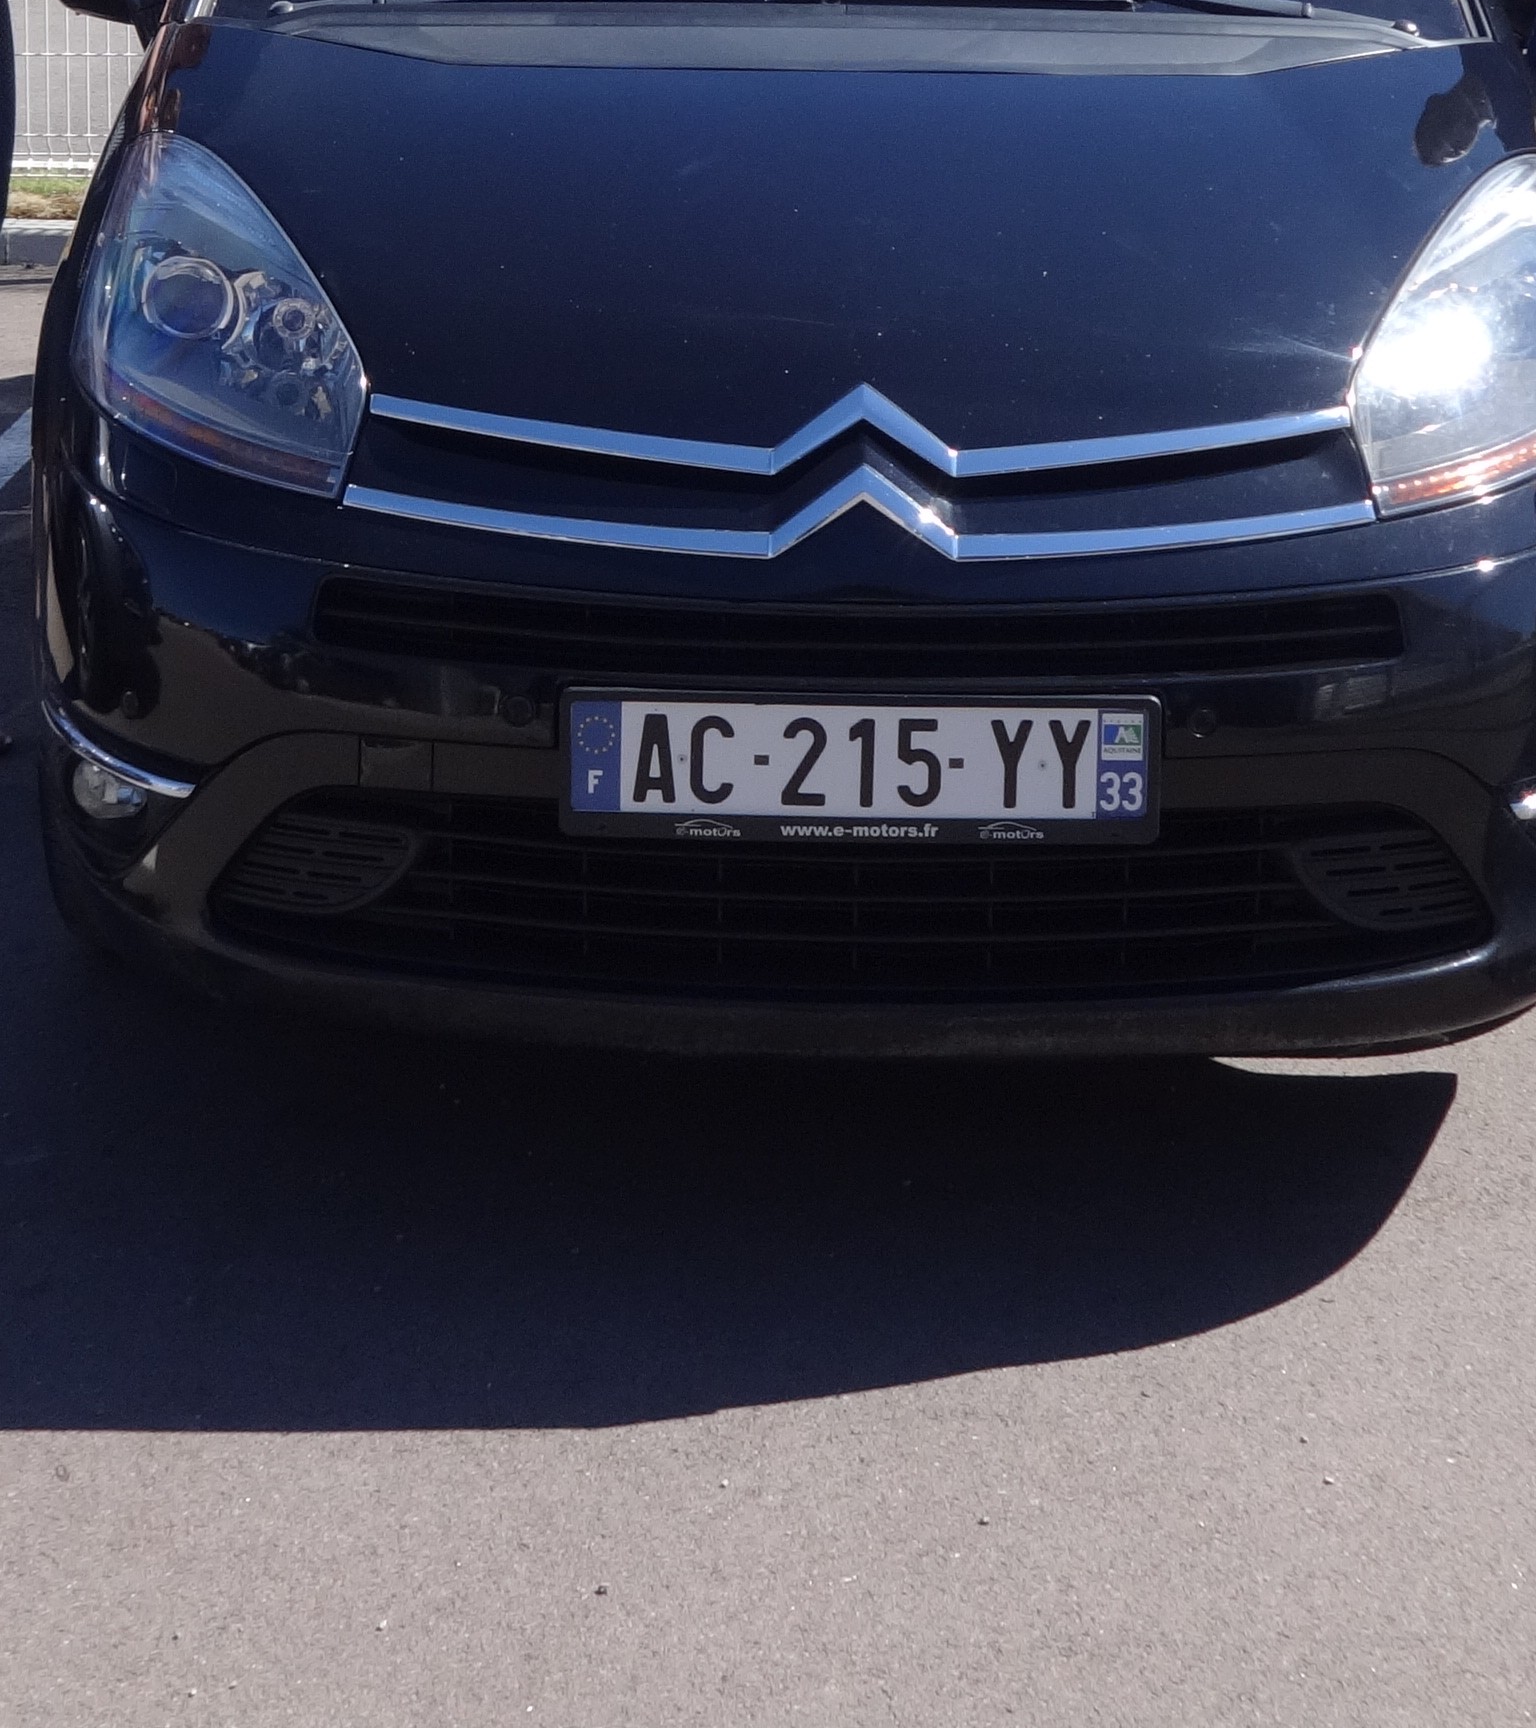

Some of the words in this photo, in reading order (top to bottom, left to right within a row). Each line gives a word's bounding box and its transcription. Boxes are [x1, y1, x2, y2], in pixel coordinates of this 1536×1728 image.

[632, 713, 1092, 809] AC-215-YY
[587, 769, 604, 794] F
[1099, 771, 1144, 811] 33
[779, 823, 939, 839] www.e-motors.fr
